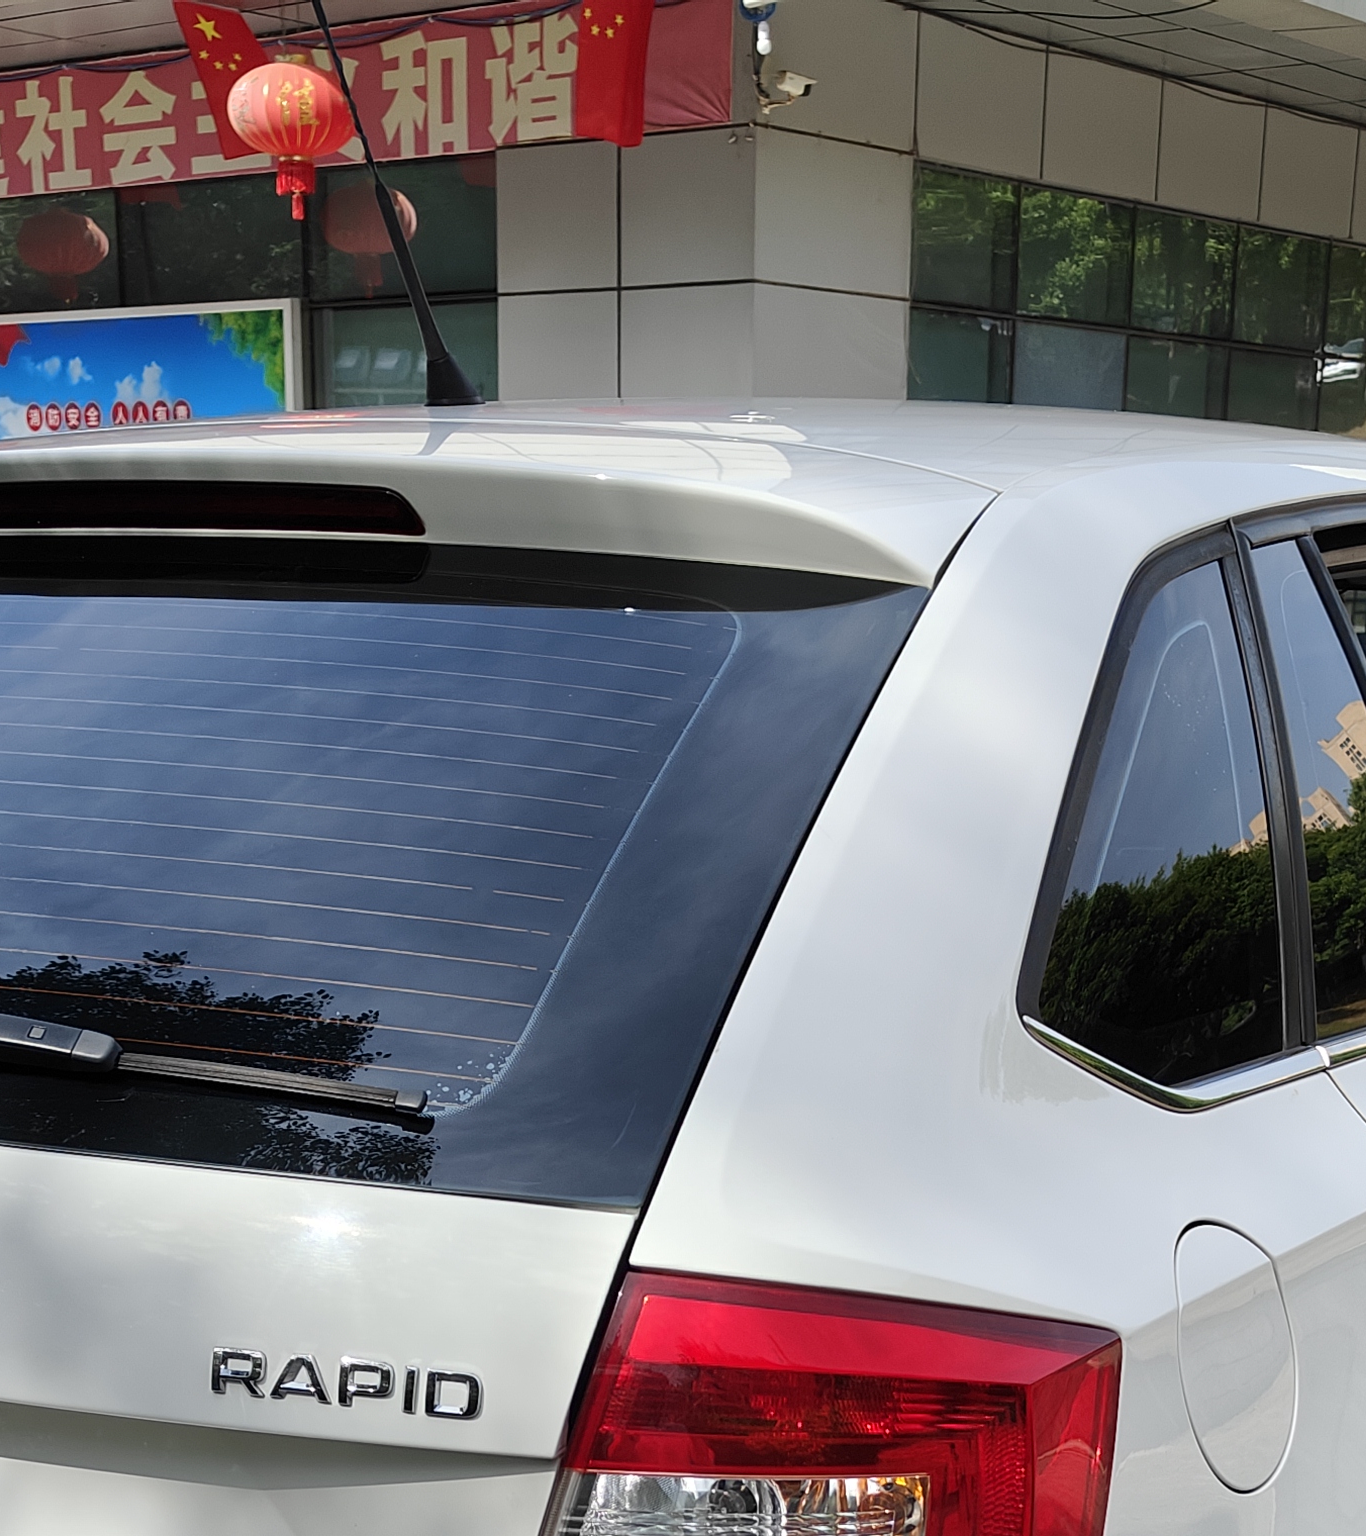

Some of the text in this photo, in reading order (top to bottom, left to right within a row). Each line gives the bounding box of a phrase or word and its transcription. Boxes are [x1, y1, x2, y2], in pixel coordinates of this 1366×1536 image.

[28, 404, 188, 428] 消防安全 人人有责
[211, 1346, 484, 1420] RAPID
